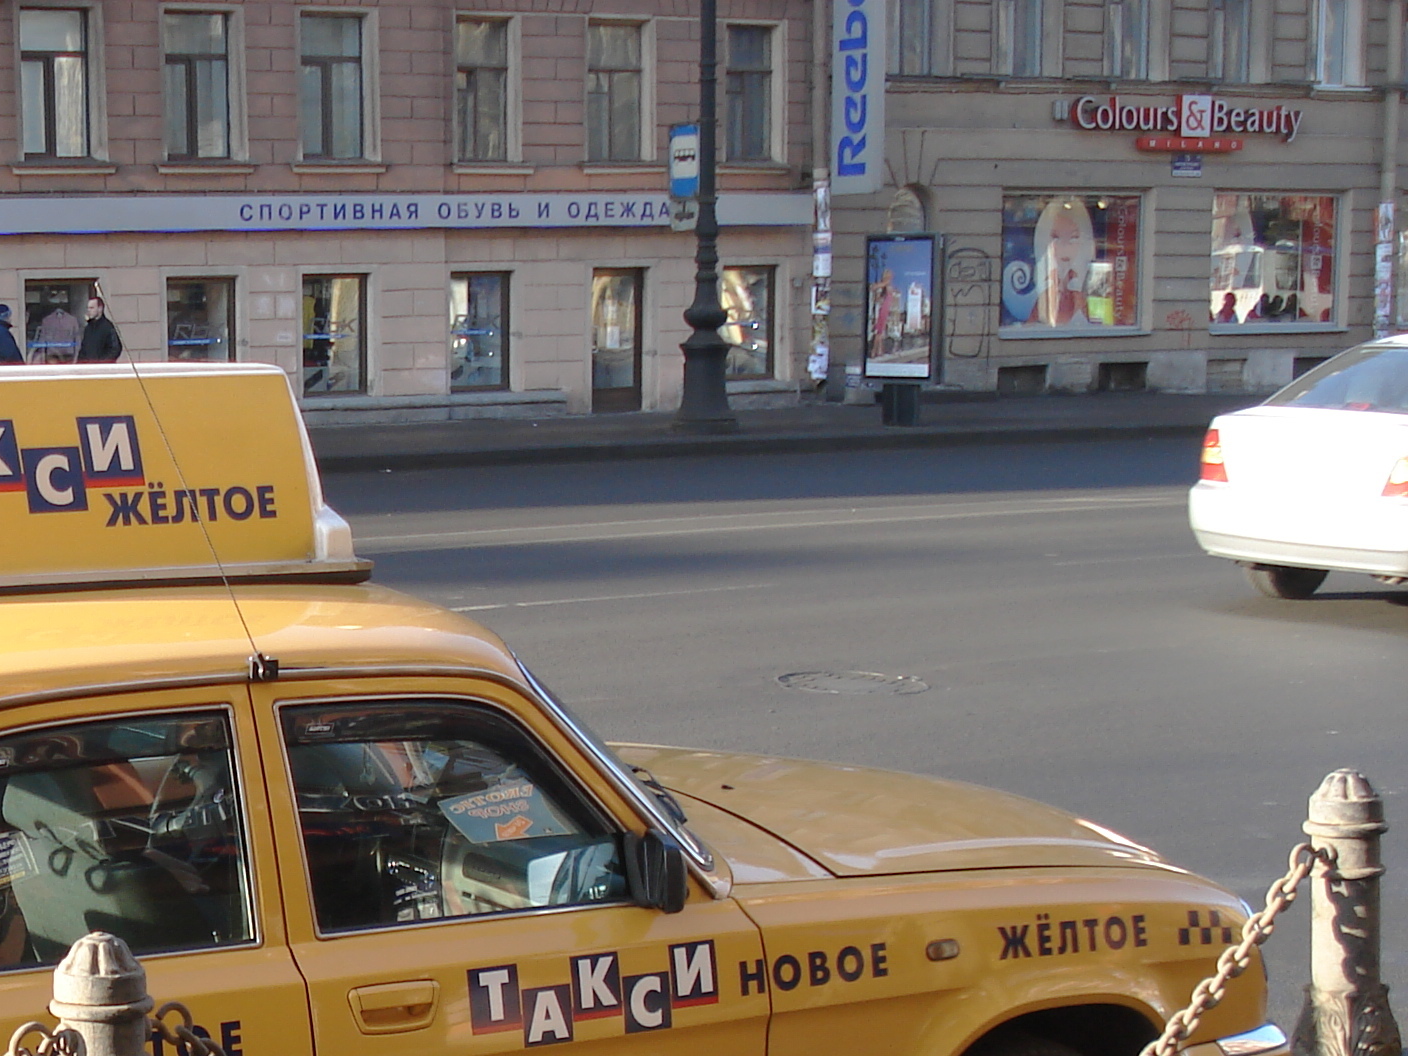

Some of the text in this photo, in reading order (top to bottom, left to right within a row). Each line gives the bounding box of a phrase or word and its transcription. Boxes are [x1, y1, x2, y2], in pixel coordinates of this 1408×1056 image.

[837, 0, 868, 177] Reeb
[1072, 96, 1304, 143] Colours & Beauty
[1148, 139, 1238, 150] MILANO
[239, 201, 671, 222] СПОРТИВНАЯ ОБУВЬ И ОДЕЖДА
[103, 481, 277, 527] ЖЁЛТОЕ
[740, 914, 1147, 997] НОВОЕ ЖЁЛТОЕ
[477, 943, 714, 1043] ТАКСИ
